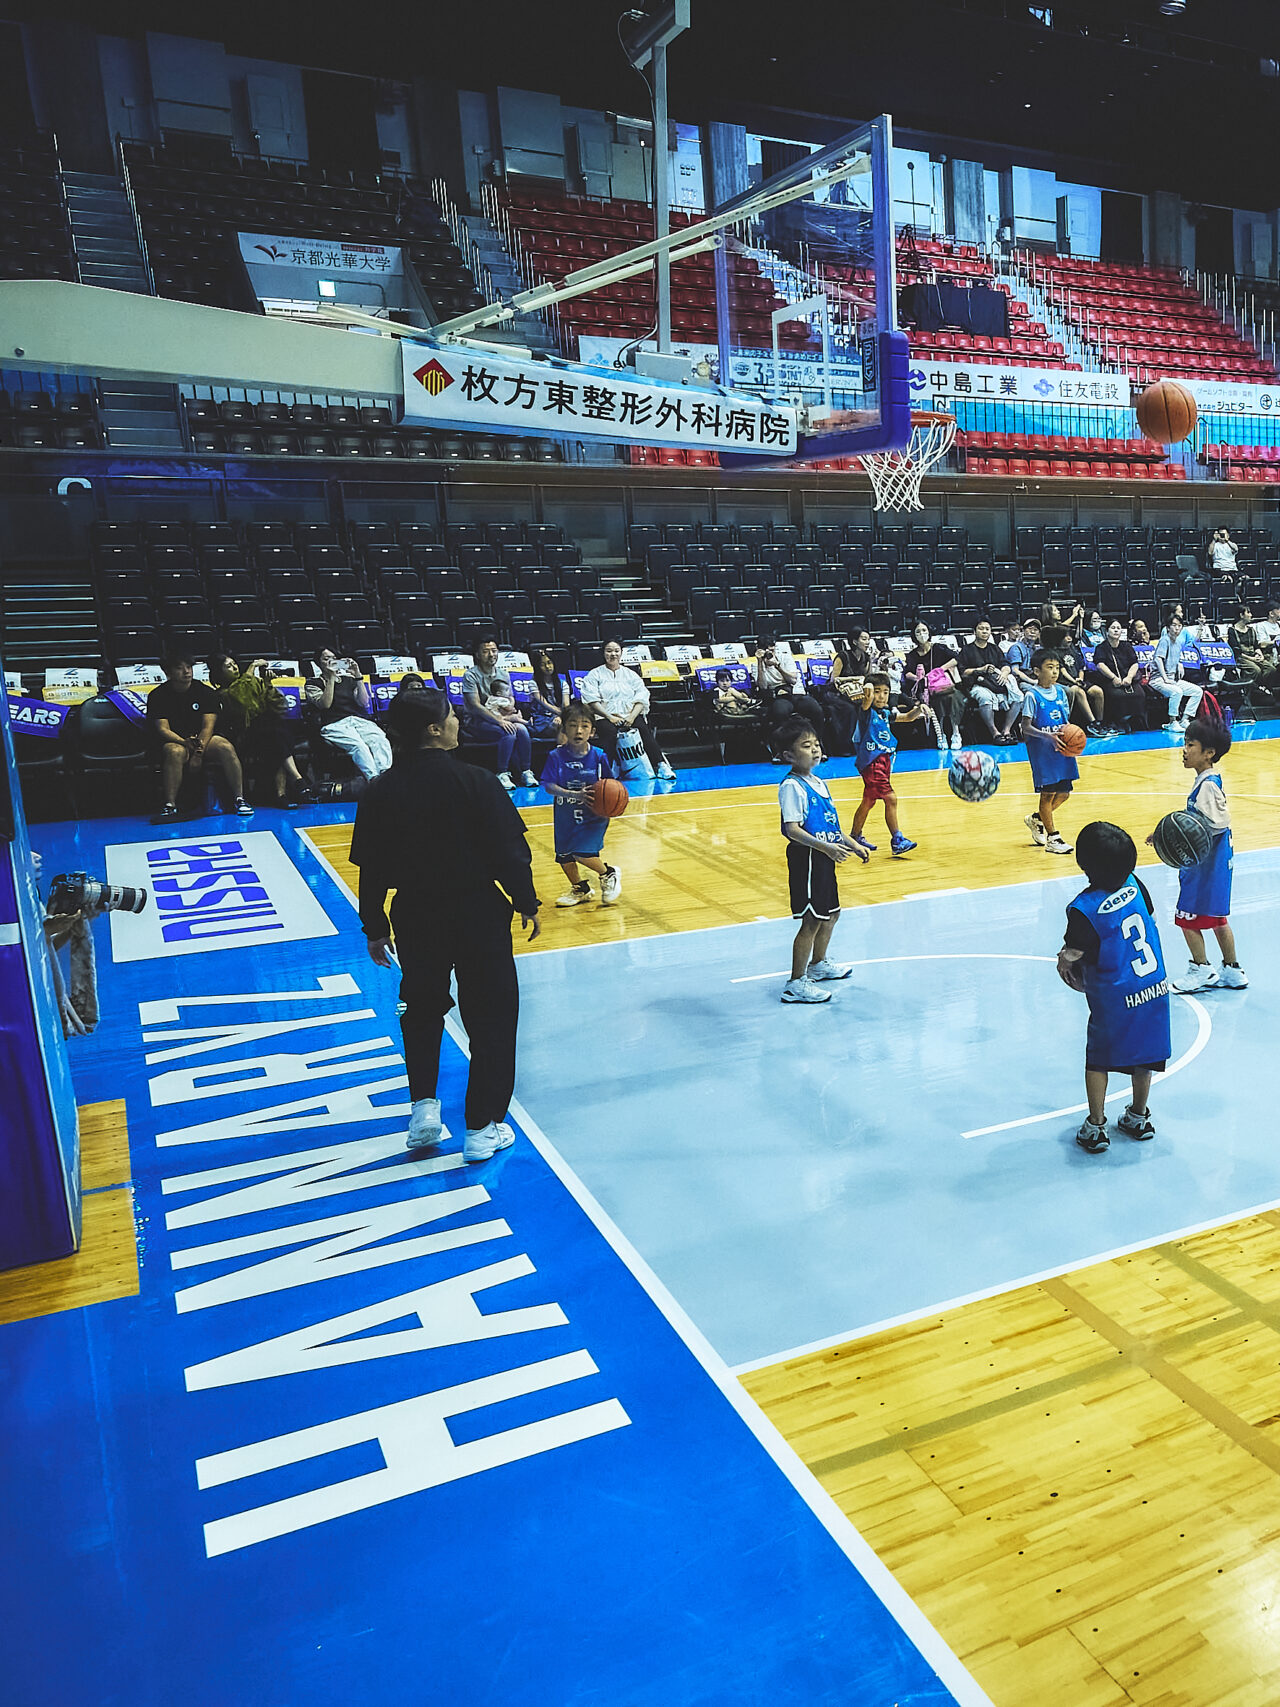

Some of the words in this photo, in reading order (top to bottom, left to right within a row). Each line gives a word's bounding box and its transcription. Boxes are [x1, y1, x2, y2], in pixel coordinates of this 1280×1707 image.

[291, 248, 391, 272] 京都光華大学
[929, 370, 1019, 396] 中島工業
[1058, 379, 1119, 400] 住友電設
[460, 365, 791, 447] 枚方東整形外科病院
[1200, 646, 1233, 658] SEARS
[573, 809, 584, 825] 5
[1102, 887, 1136, 912] deps
[1121, 912, 1158, 979] 3
[1125, 980, 1170, 1009] HANNAR
[138, 972, 634, 1559] HANNARYZ
